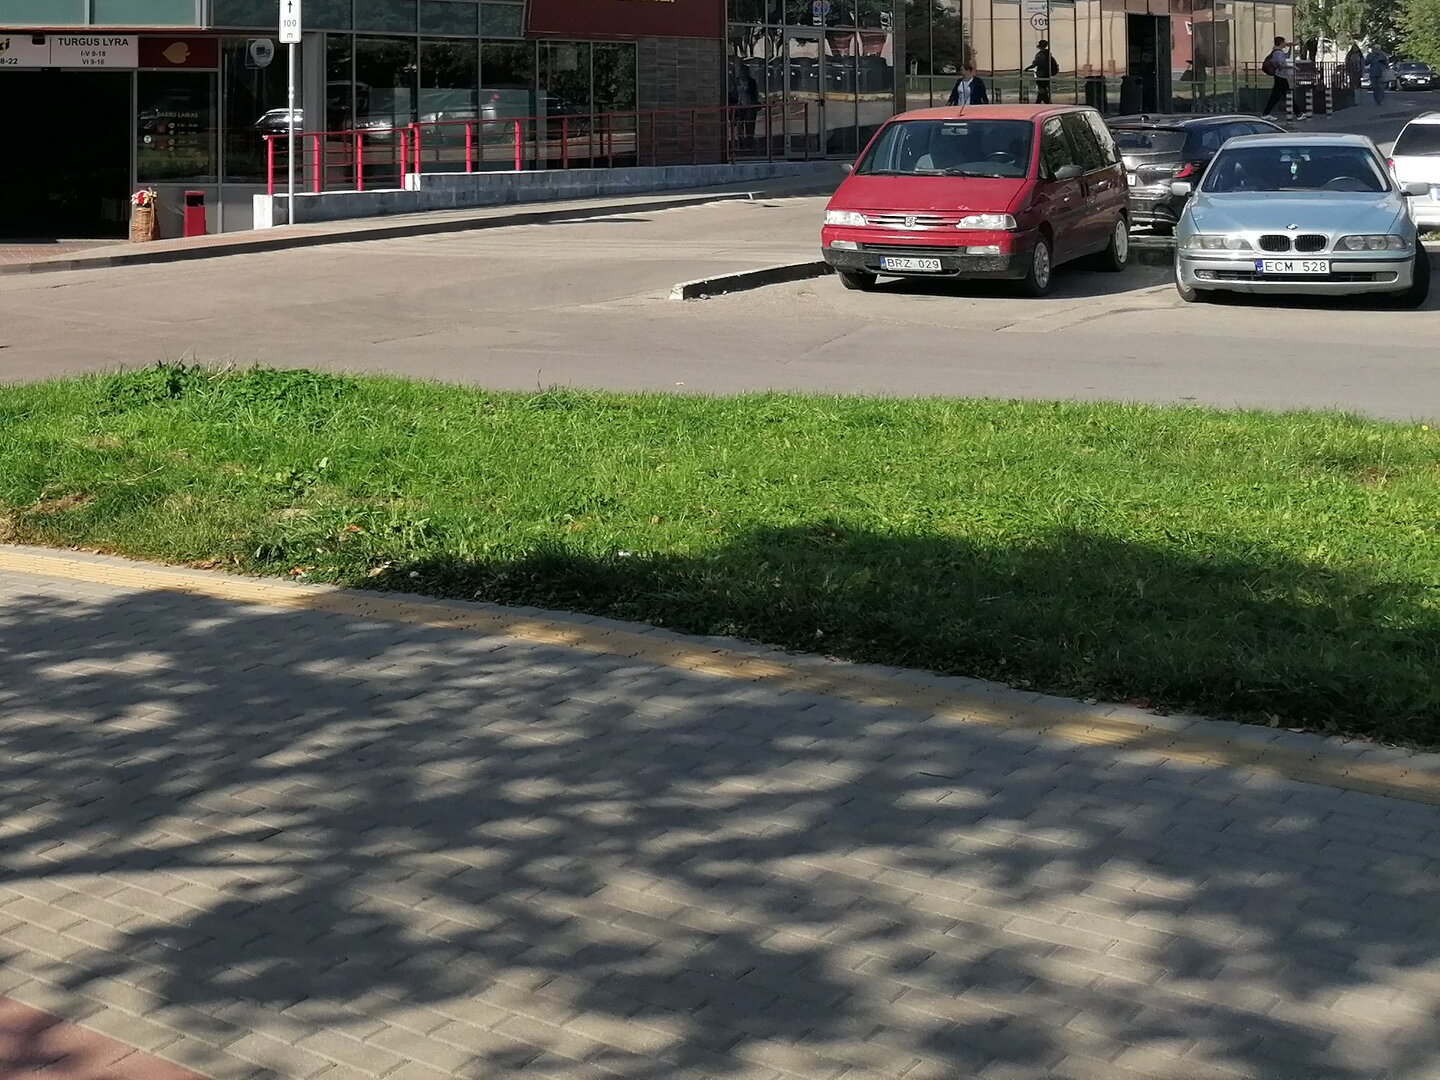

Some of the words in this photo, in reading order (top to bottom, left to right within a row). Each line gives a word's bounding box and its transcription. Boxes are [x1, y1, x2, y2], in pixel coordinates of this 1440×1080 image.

[283, 19, 297, 27] 100
[58, 37, 100, 47] TURGUS
[102, 37, 129, 47] LYRA
[0, 57, 18, 65] 8-22
[887, 258, 911, 268] BRZ
[918, 259, 939, 269] 029
[1265, 262, 1293, 272] ECM
[1302, 262, 1327, 272] 528
